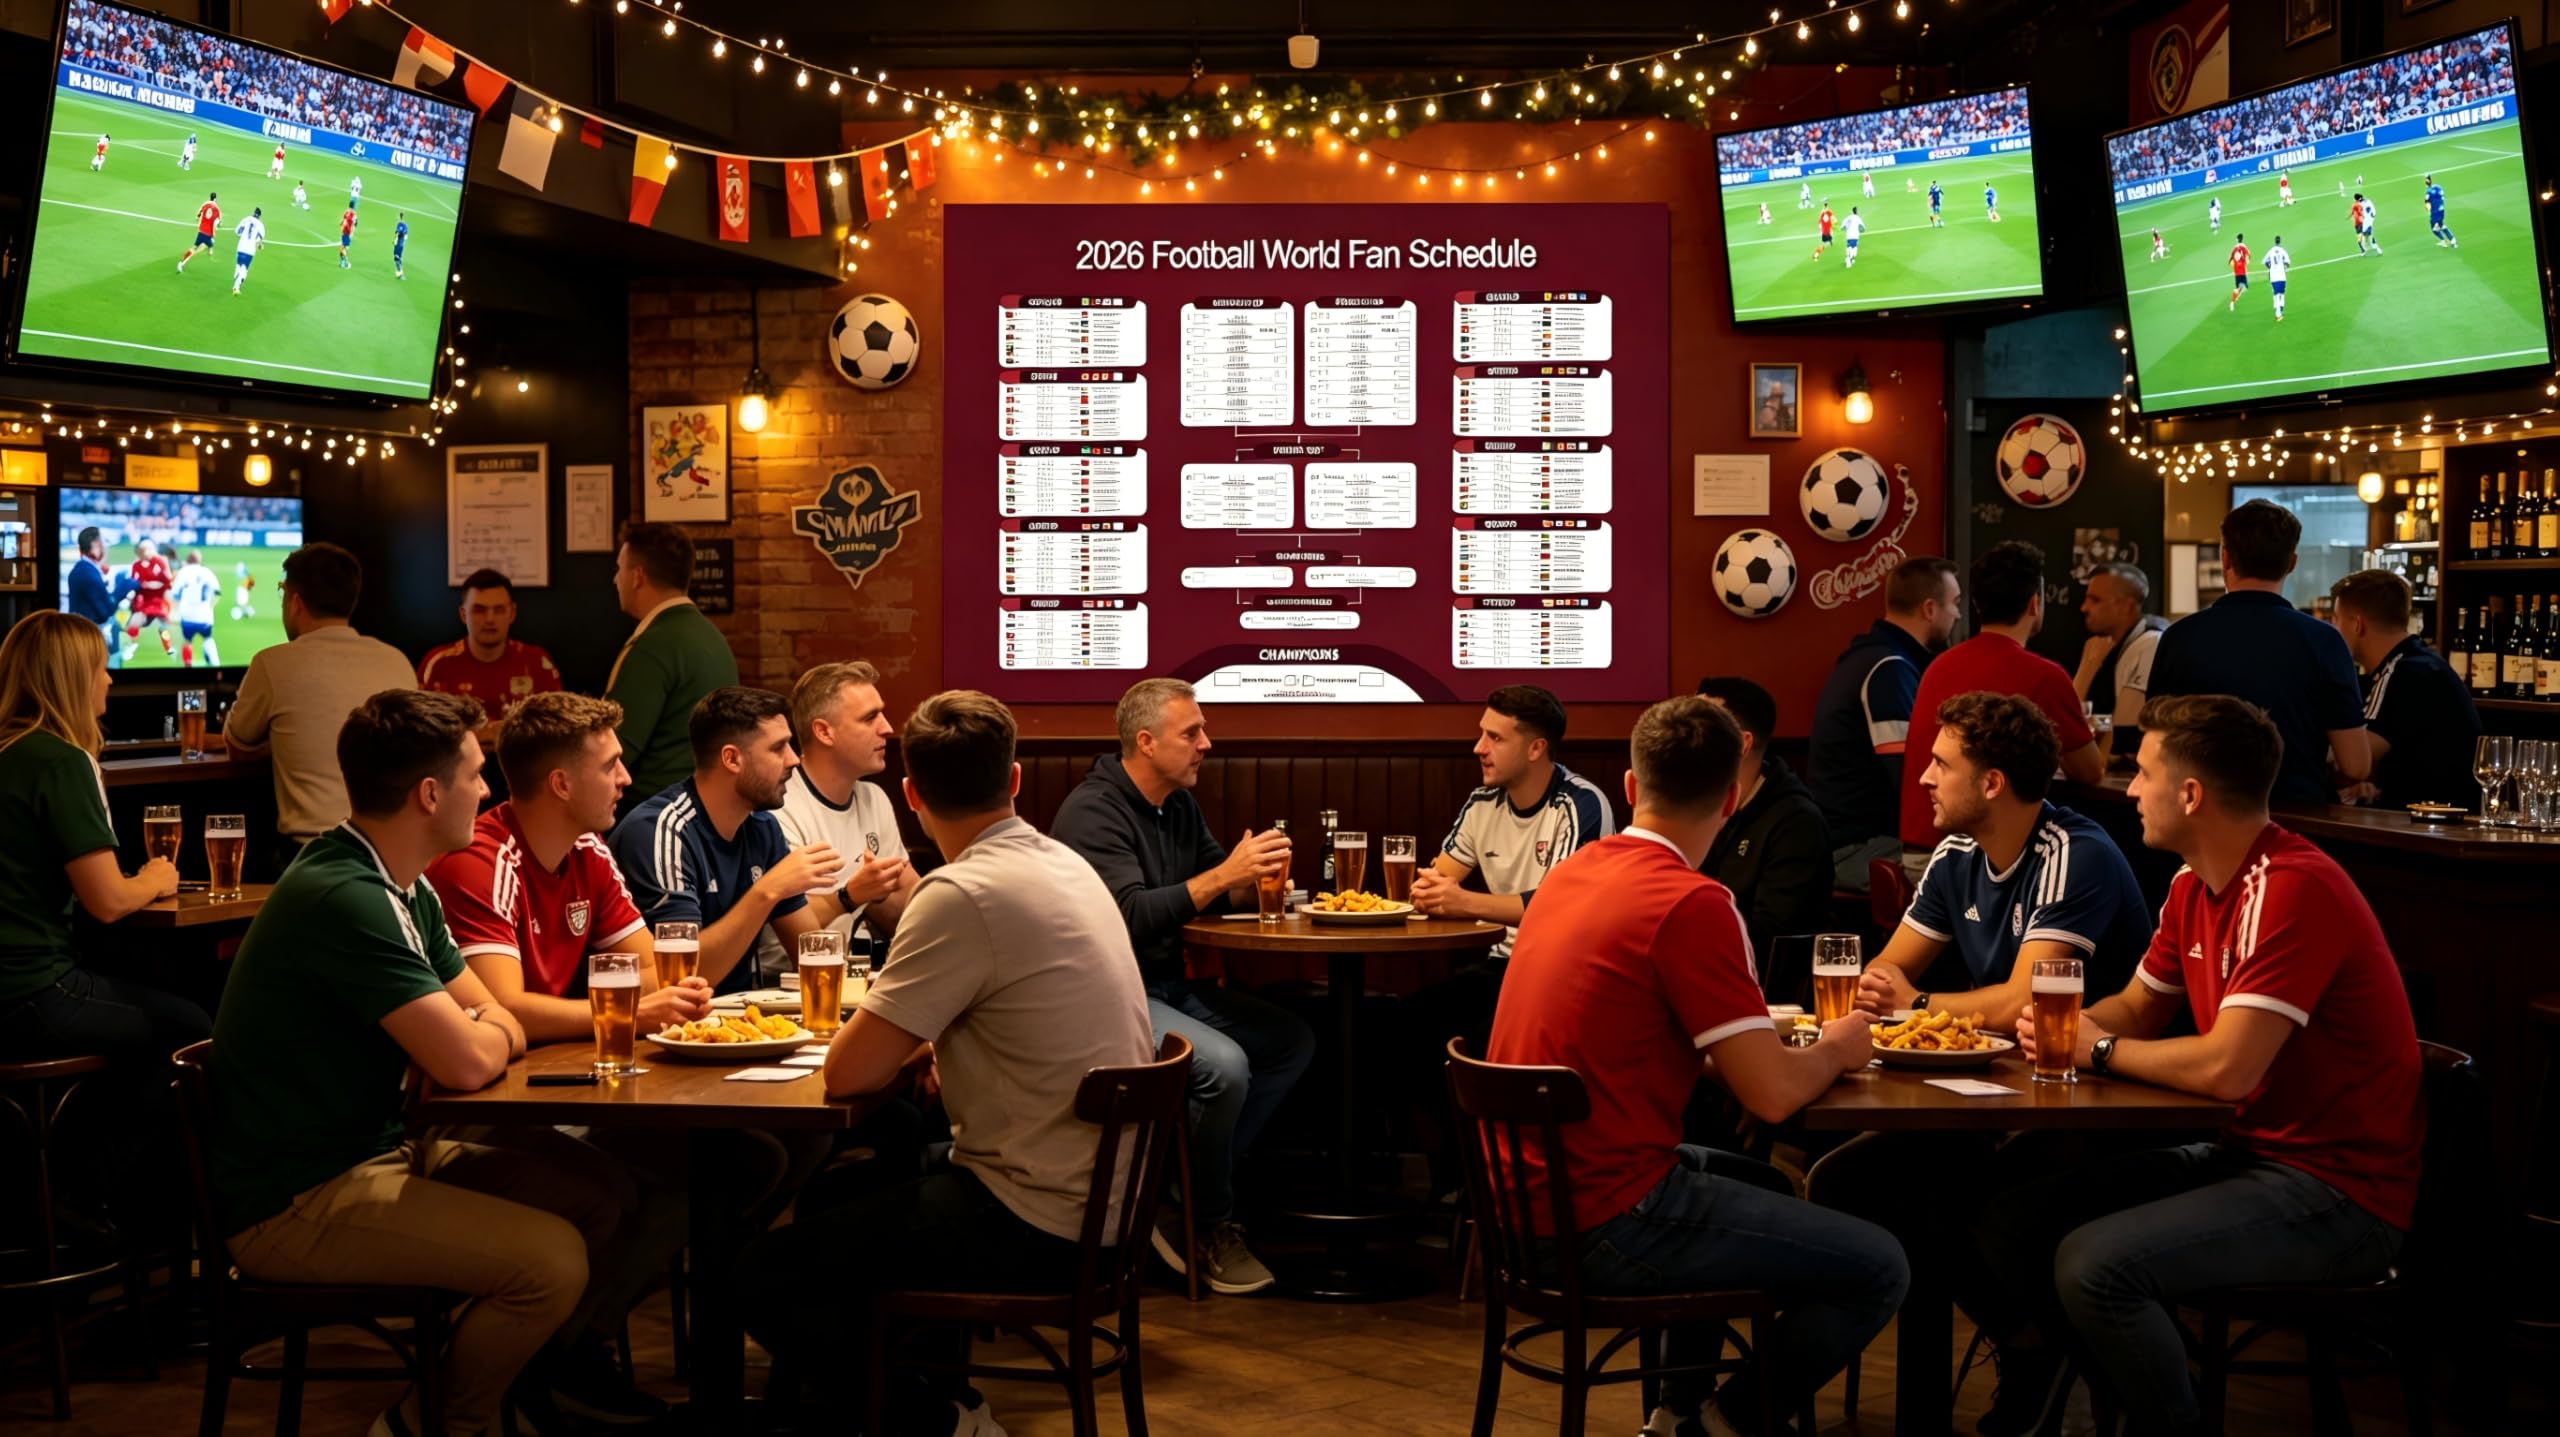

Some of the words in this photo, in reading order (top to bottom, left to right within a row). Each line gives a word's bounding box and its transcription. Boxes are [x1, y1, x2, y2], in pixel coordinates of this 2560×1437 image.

[1075, 239, 1144, 269] 2026
[1152, 239, 1254, 269] Football
[1262, 239, 1340, 269] World
[1348, 239, 1400, 269] Fan
[1408, 237, 1537, 268] Schedule
